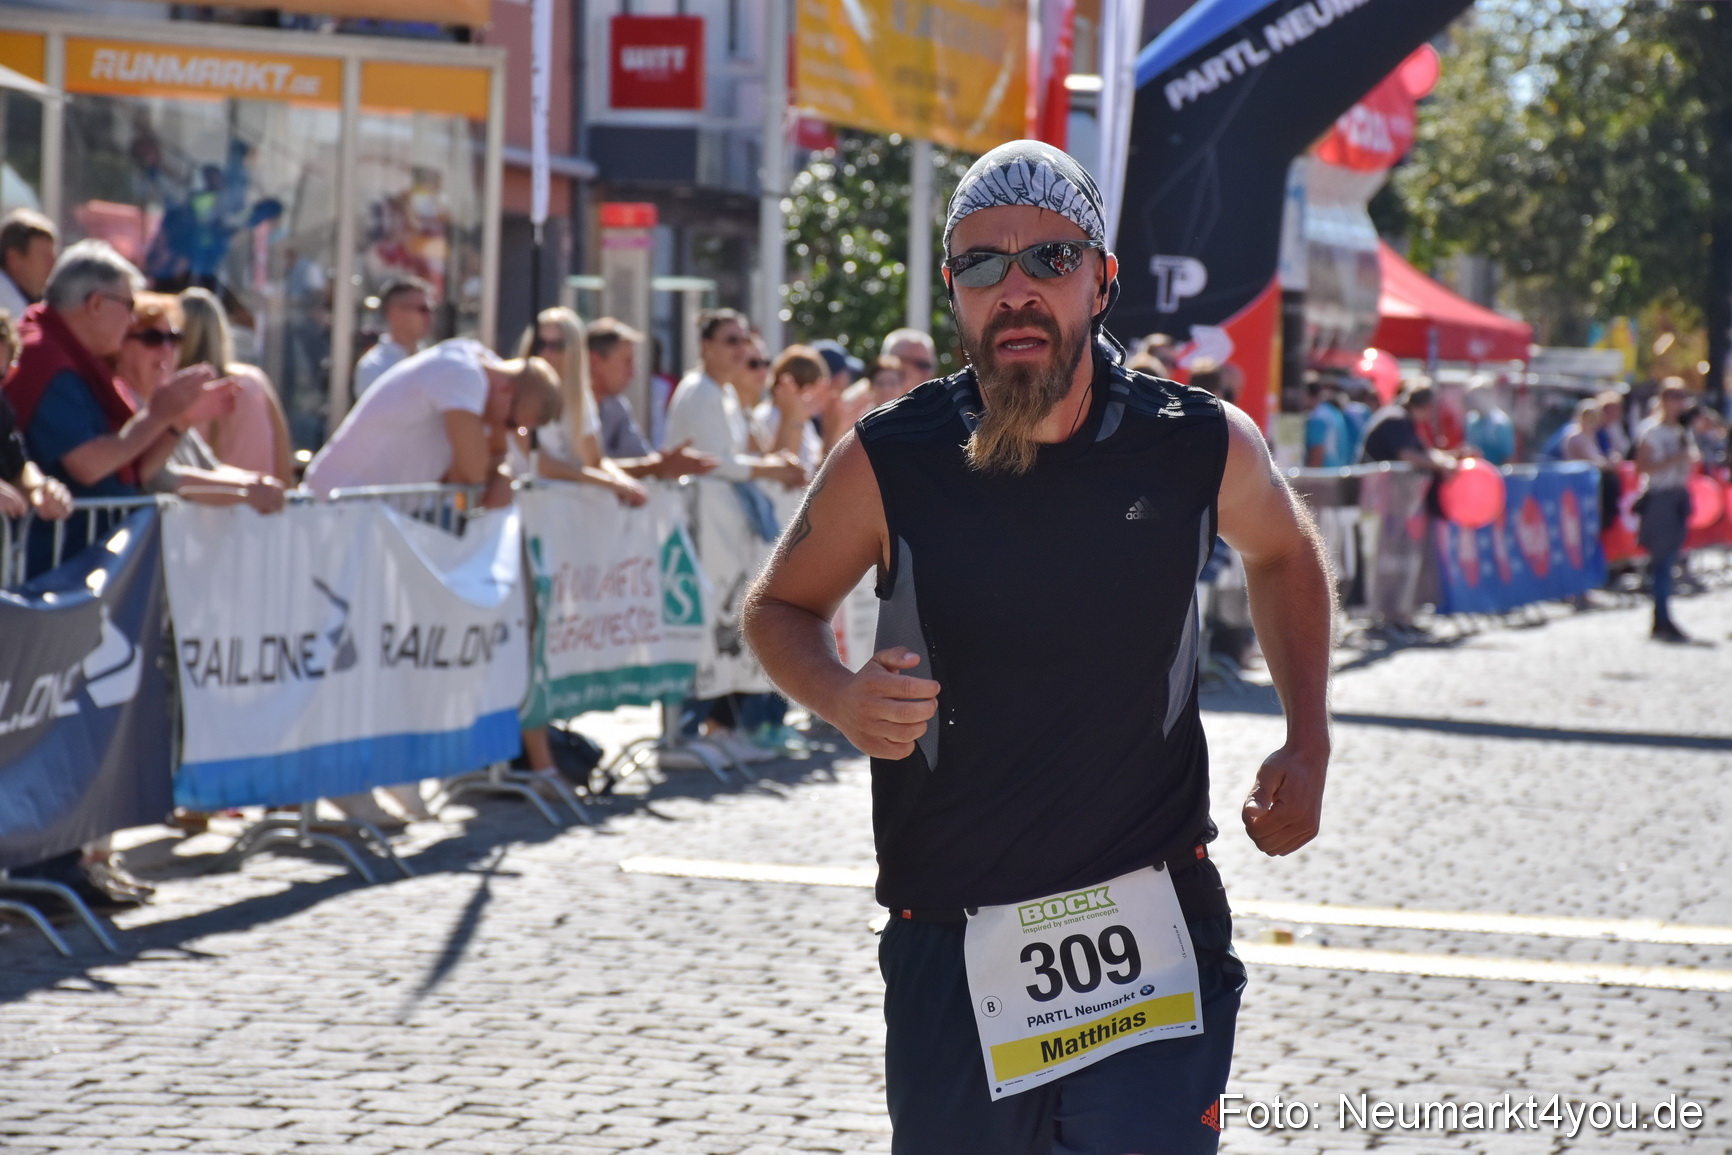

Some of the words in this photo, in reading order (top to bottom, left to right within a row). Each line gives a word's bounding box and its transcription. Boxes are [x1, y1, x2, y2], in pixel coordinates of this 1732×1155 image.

[1164, 38, 1270, 111] PARTL
[181, 632, 325, 687] RAIL.ONE
[379, 621, 509, 669] RAIL.ON
[1018, 886, 1116, 926] BOCK
[1022, 921, 1052, 934] inspired
[1053, 920, 1062, 928] by
[1064, 915, 1085, 925] smart
[1086, 908, 1119, 920] concepts
[1020, 925, 1142, 1002] 309
[986, 1001, 996, 1013] B
[1027, 1009, 1073, 1028] PARTL
[1074, 991, 1136, 1017] Neumarkt
[1040, 1011, 1147, 1063] Matthias
